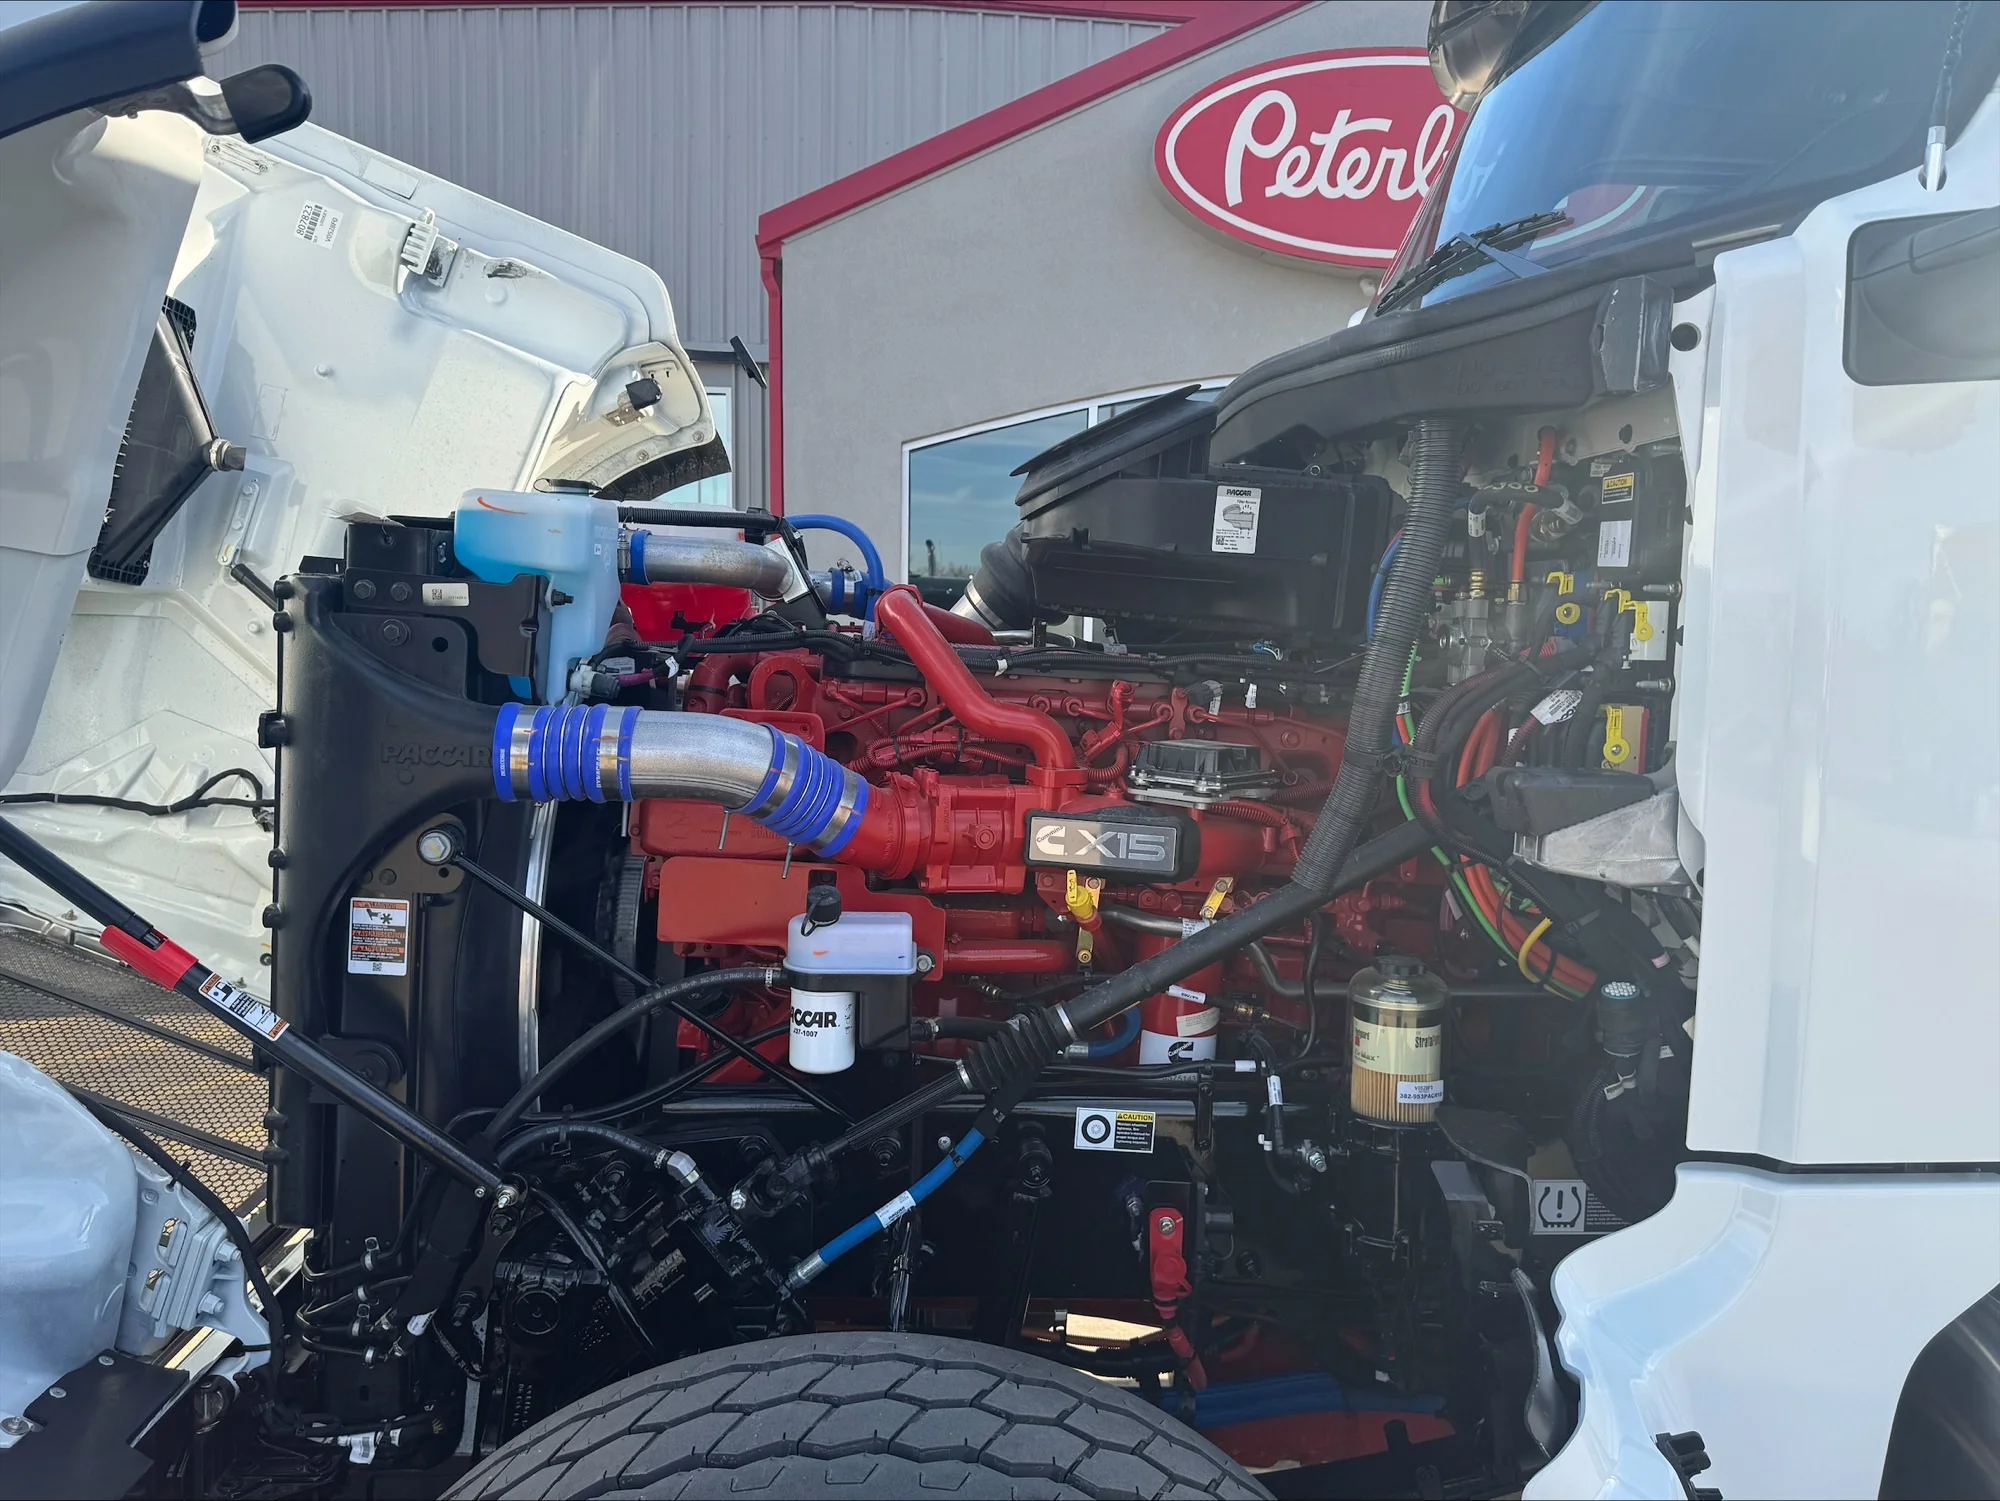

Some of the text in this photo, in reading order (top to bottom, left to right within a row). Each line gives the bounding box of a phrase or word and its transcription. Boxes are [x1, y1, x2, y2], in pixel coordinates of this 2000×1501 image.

[296, 205, 313, 236] 807823
[381, 742, 492, 768] PACCAR
[1036, 826, 1064, 843] Cummins
[1075, 829, 1165, 862] X15
[791, 1006, 837, 1028] ACCAR
[1168, 1041, 1192, 1057] Cummins
[1123, 1113, 1153, 1121] CAUTION
